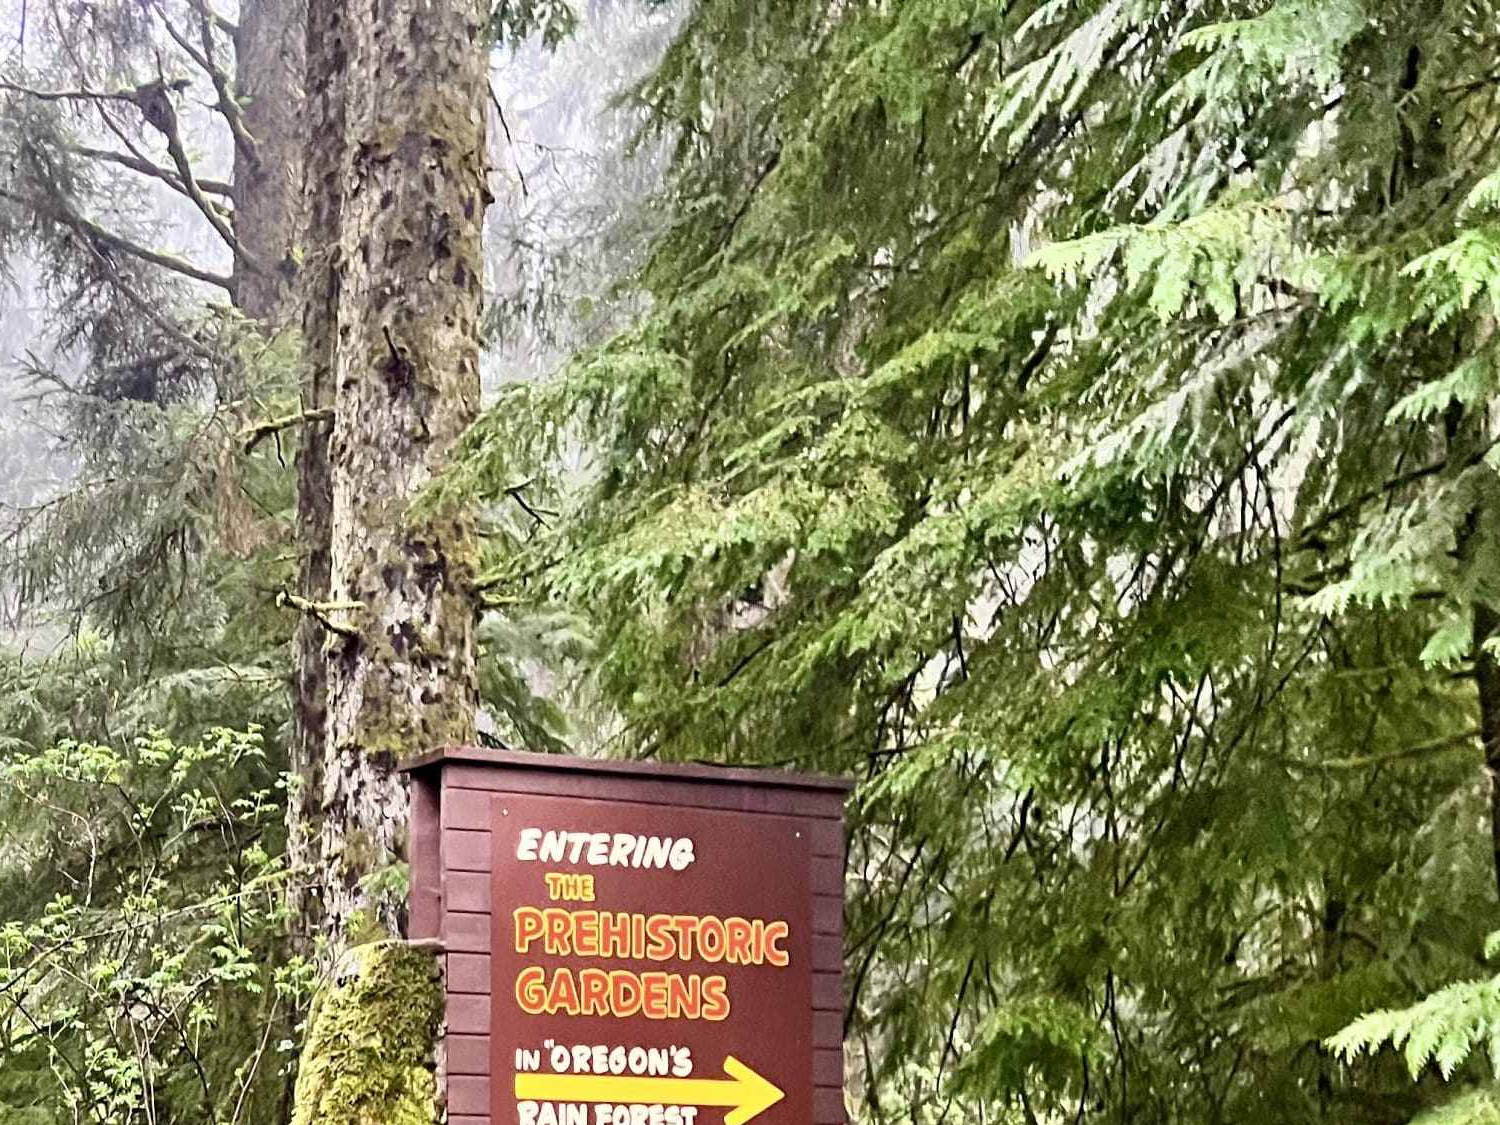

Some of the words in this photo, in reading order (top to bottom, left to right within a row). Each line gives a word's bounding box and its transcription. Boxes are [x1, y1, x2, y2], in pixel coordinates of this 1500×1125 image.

[516, 828, 696, 870] ENTERING
[545, 873, 595, 901] THE
[513, 907, 791, 966] PREHISTORIC
[515, 967, 730, 1021] GARDENS
[515, 1047, 541, 1071] IN
